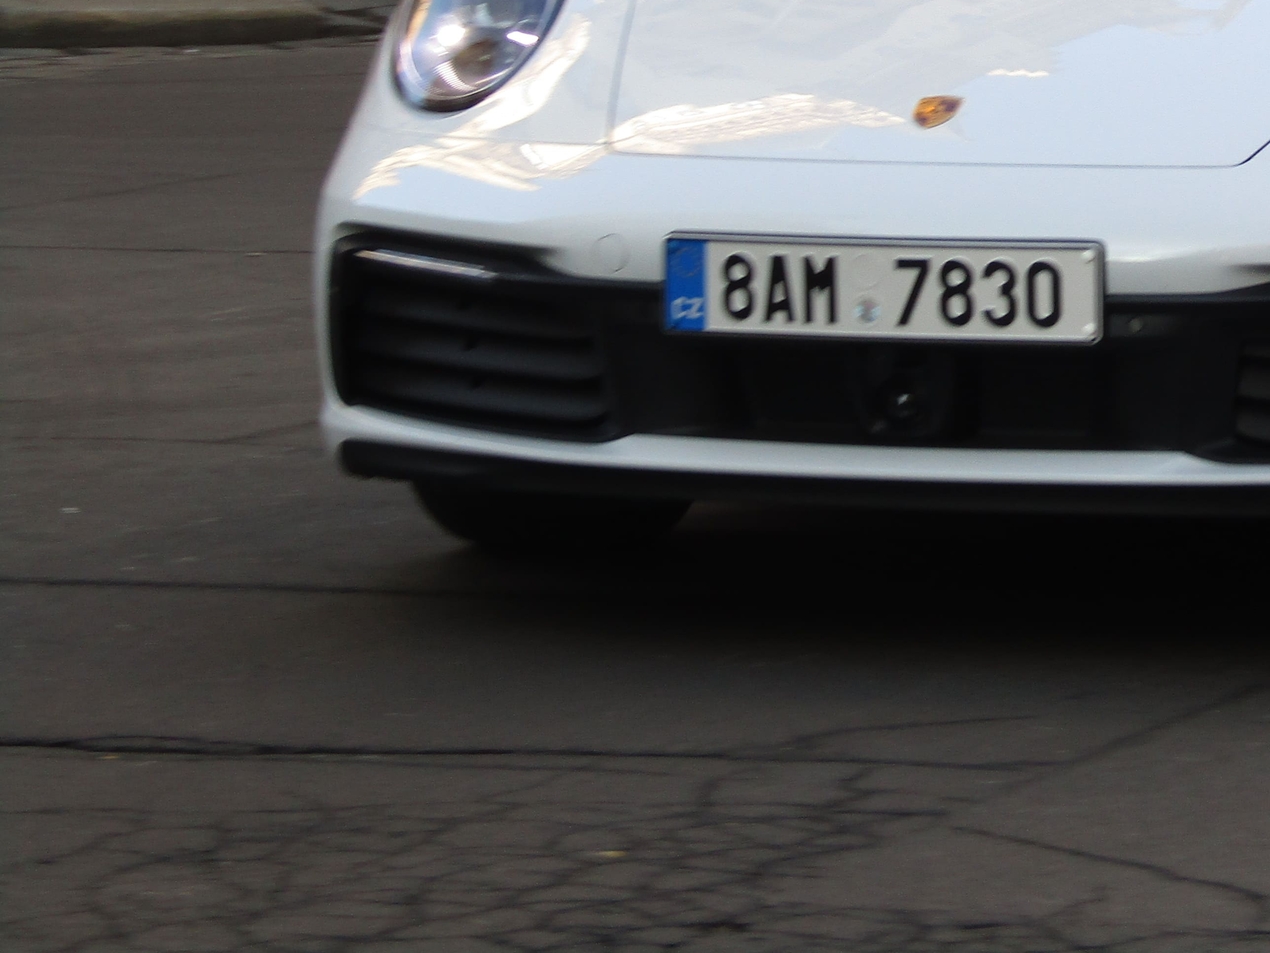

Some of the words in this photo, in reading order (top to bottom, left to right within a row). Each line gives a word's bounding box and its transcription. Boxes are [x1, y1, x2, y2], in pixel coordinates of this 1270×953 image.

[670, 296, 703, 319] CZ
[721, 253, 839, 325] 8AM
[895, 257, 1063, 330] 7830
